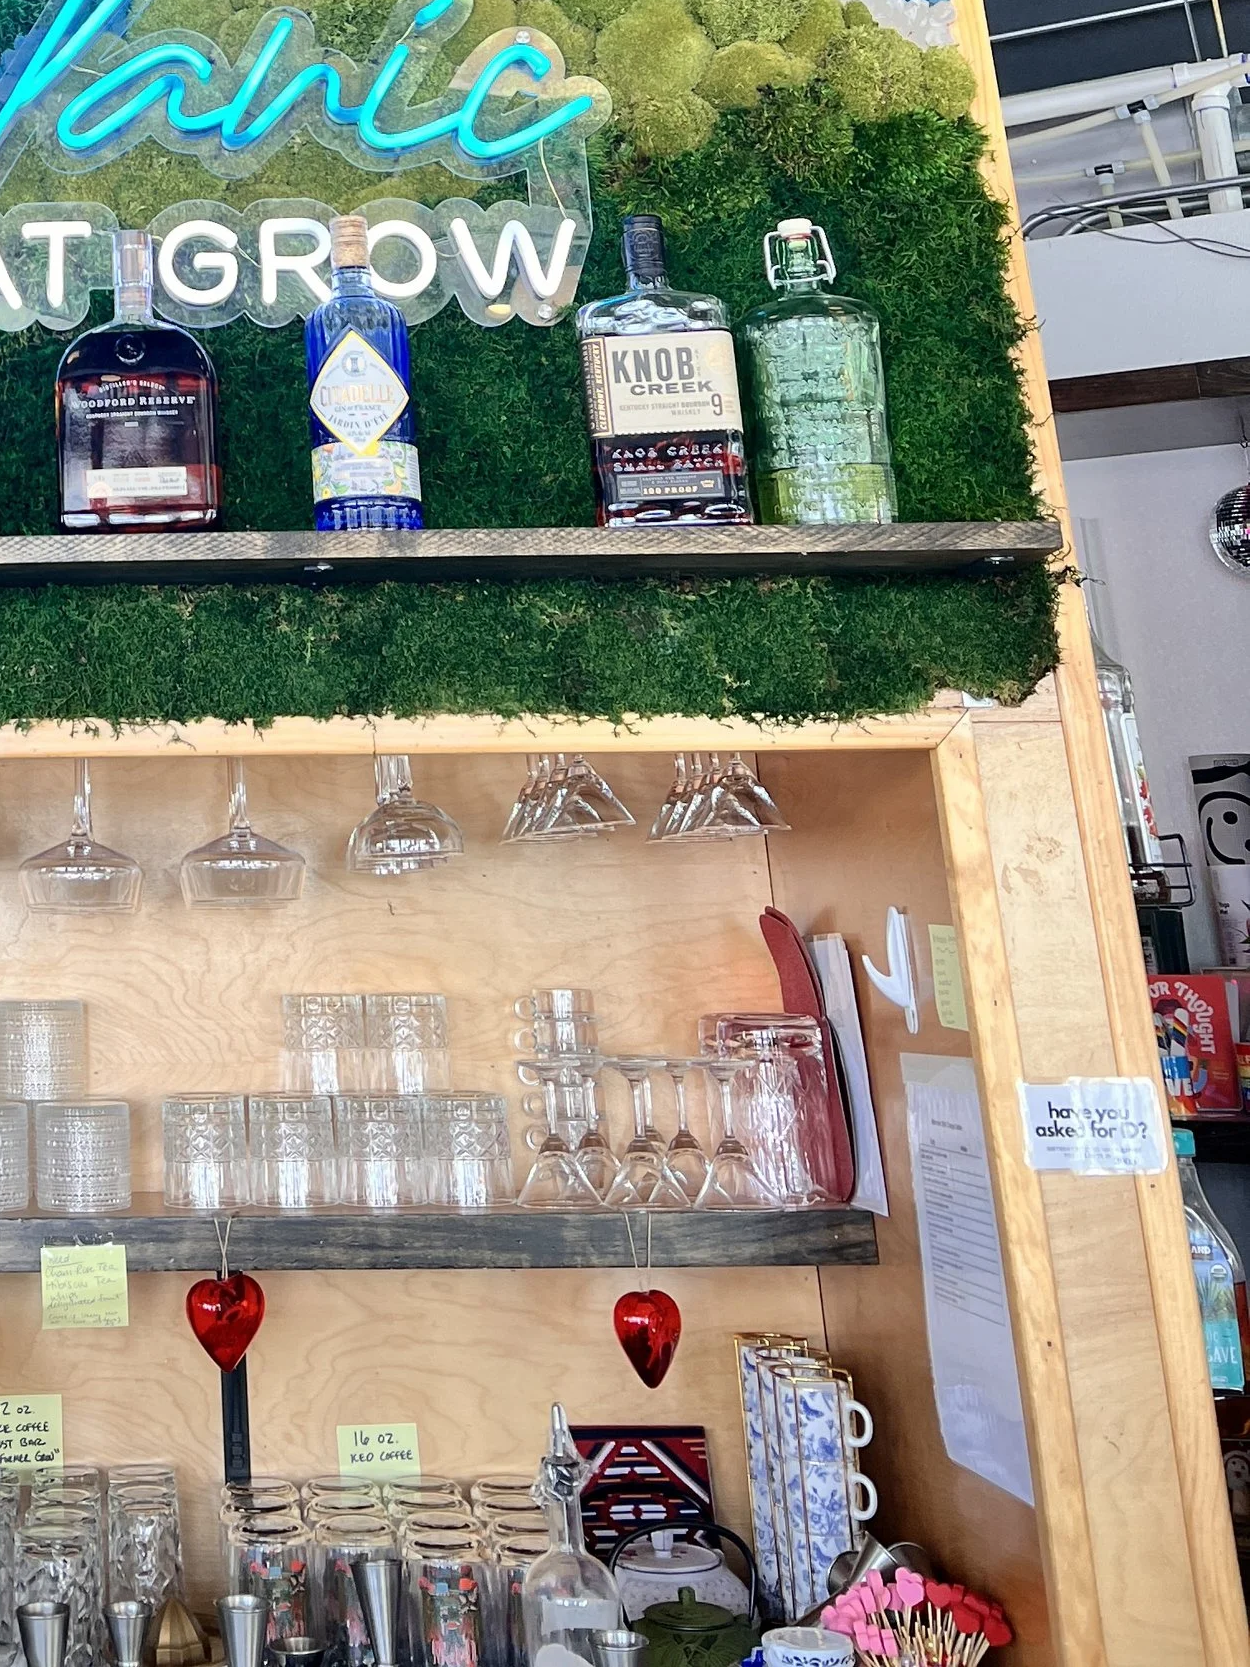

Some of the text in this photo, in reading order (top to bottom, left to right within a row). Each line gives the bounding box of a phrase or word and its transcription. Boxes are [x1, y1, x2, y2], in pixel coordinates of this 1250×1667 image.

[158, 218, 577, 309] GROW
[612, 346, 695, 384] KNOB
[319, 383, 396, 408] CITADELLE
[630, 380, 714, 395] CREEK
[70, 395, 195, 409] WOODFORD RESERVE
[711, 393, 723, 416] 9
[664, 485, 698, 494] PROOF
[1174, 981, 1217, 1055] THOUGHT
[1047, 1100, 1130, 1124] have you
[1035, 1120, 1148, 1140] asked for ID?
[15, 1421, 50, 1433] COFFEE
[19, 1437, 47, 1447] BAR
[353, 1430, 370, 1447] 16
[379, 1449, 414, 1462] COFFEE
